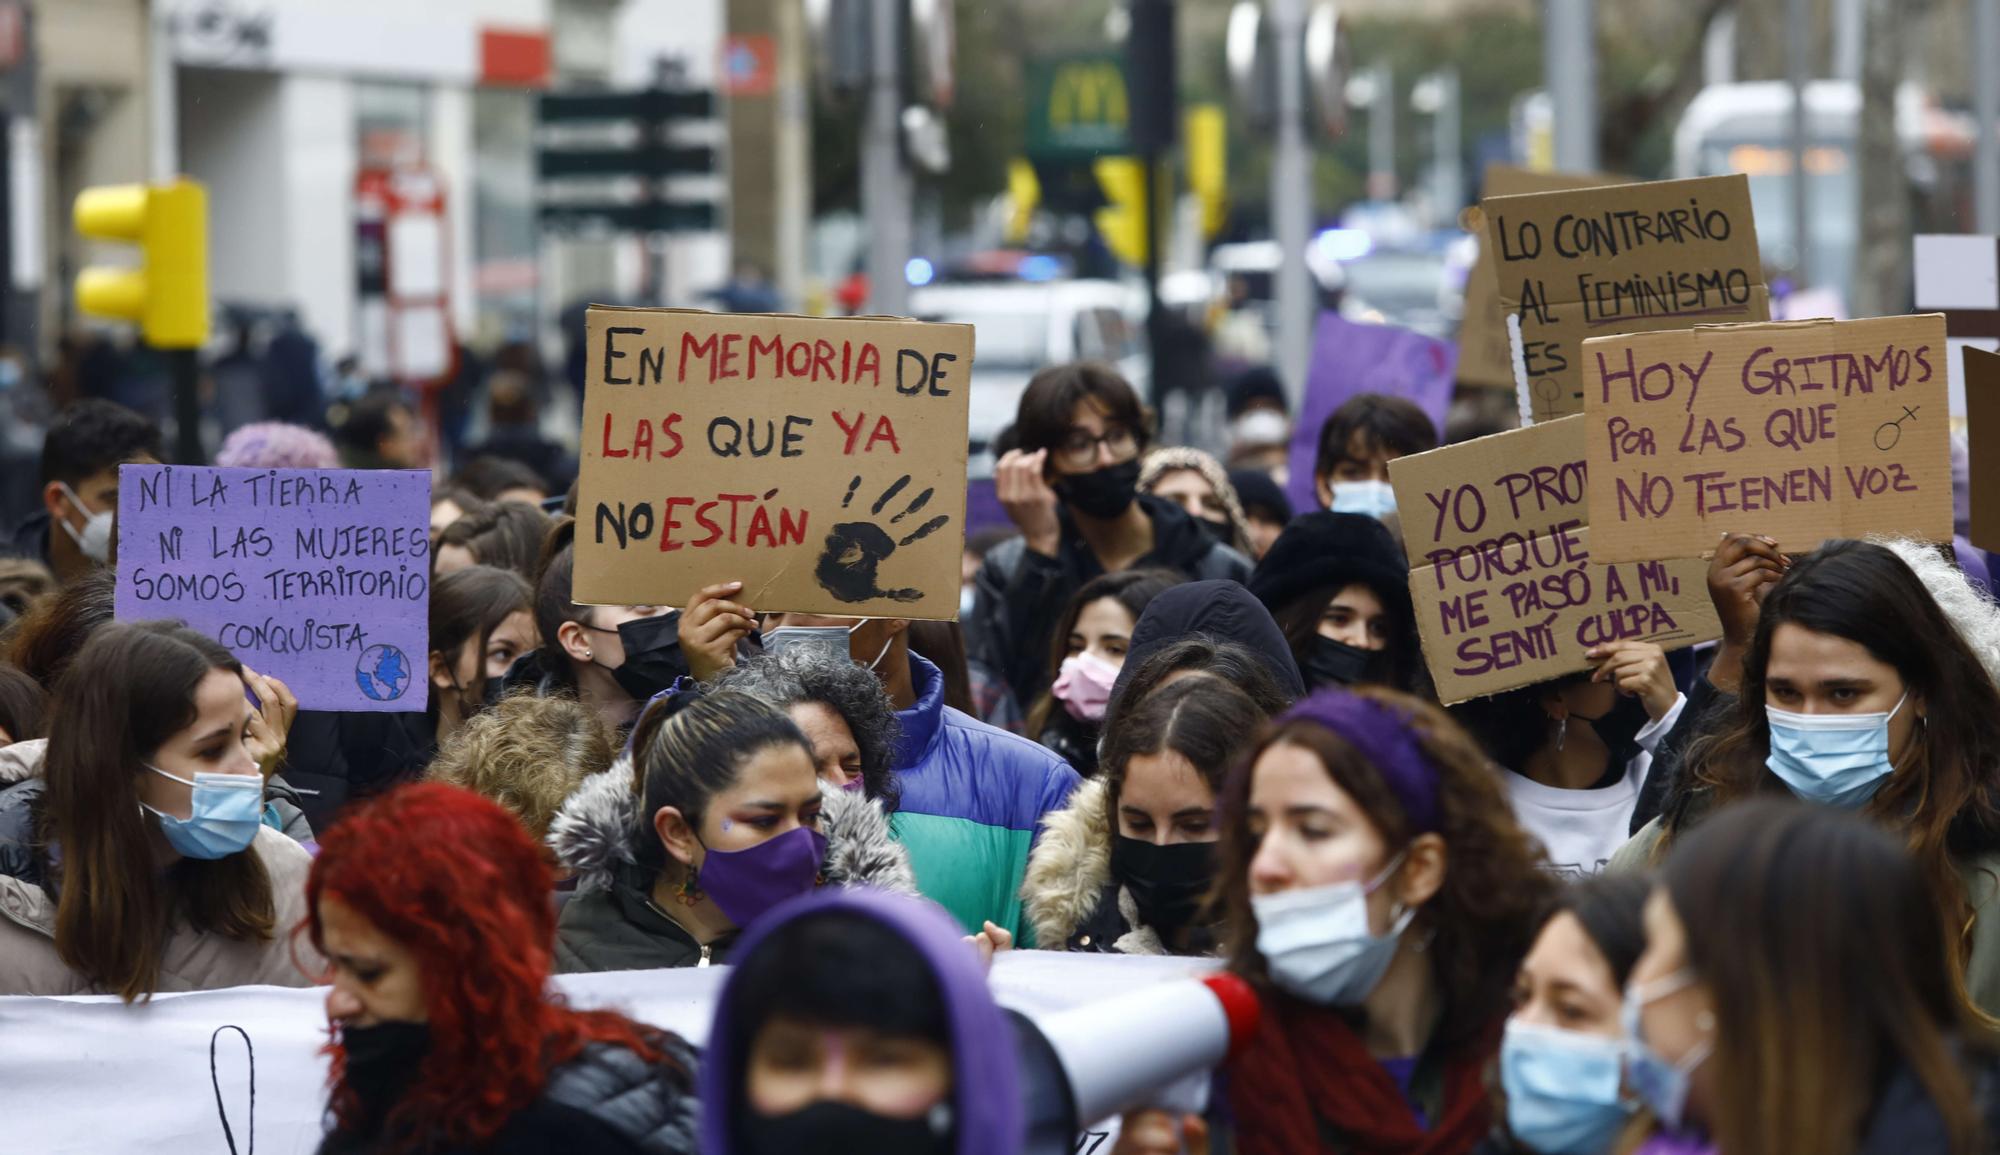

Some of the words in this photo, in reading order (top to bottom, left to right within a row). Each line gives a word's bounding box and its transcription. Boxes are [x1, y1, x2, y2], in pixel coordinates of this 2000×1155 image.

[1498, 215, 1542, 262] LO
[1553, 198, 1731, 259] CONTRARIO
[1518, 278, 1559, 327] AL
[677, 330, 881, 387] MEMORIA
[896, 348, 958, 397] DE
[1523, 341, 1568, 377] ES
[1595, 348, 1714, 412] HOY
[1741, 344, 1933, 397] GRITAMOS
[601, 412, 685, 463] LAS
[707, 415, 813, 458] QUE
[831, 411, 901, 455] YA
[1606, 416, 1656, 462] POR
[1678, 413, 1746, 456] LAS
[1764, 403, 1838, 451] QUE
[192, 472, 229, 508] LA
[1425, 483, 1487, 543] YO
[1616, 471, 1674, 522] NO
[1683, 465, 1832, 517] TIENEN
[1844, 463, 1919, 500] VOZ
[211, 526, 273, 559] LAS
[295, 525, 429, 560] MUJERES
[595, 501, 655, 550] NO
[660, 488, 809, 552] ESTÁN
[1425, 518, 1590, 591] PORQUE
[132, 567, 245, 602] SOMOS
[1438, 589, 1490, 636] ME
[1501, 561, 1592, 620] PASÓ
[1606, 564, 1628, 603] A
[1453, 612, 1559, 677] SENTÍ
[1575, 602, 1678, 647] CULPA
